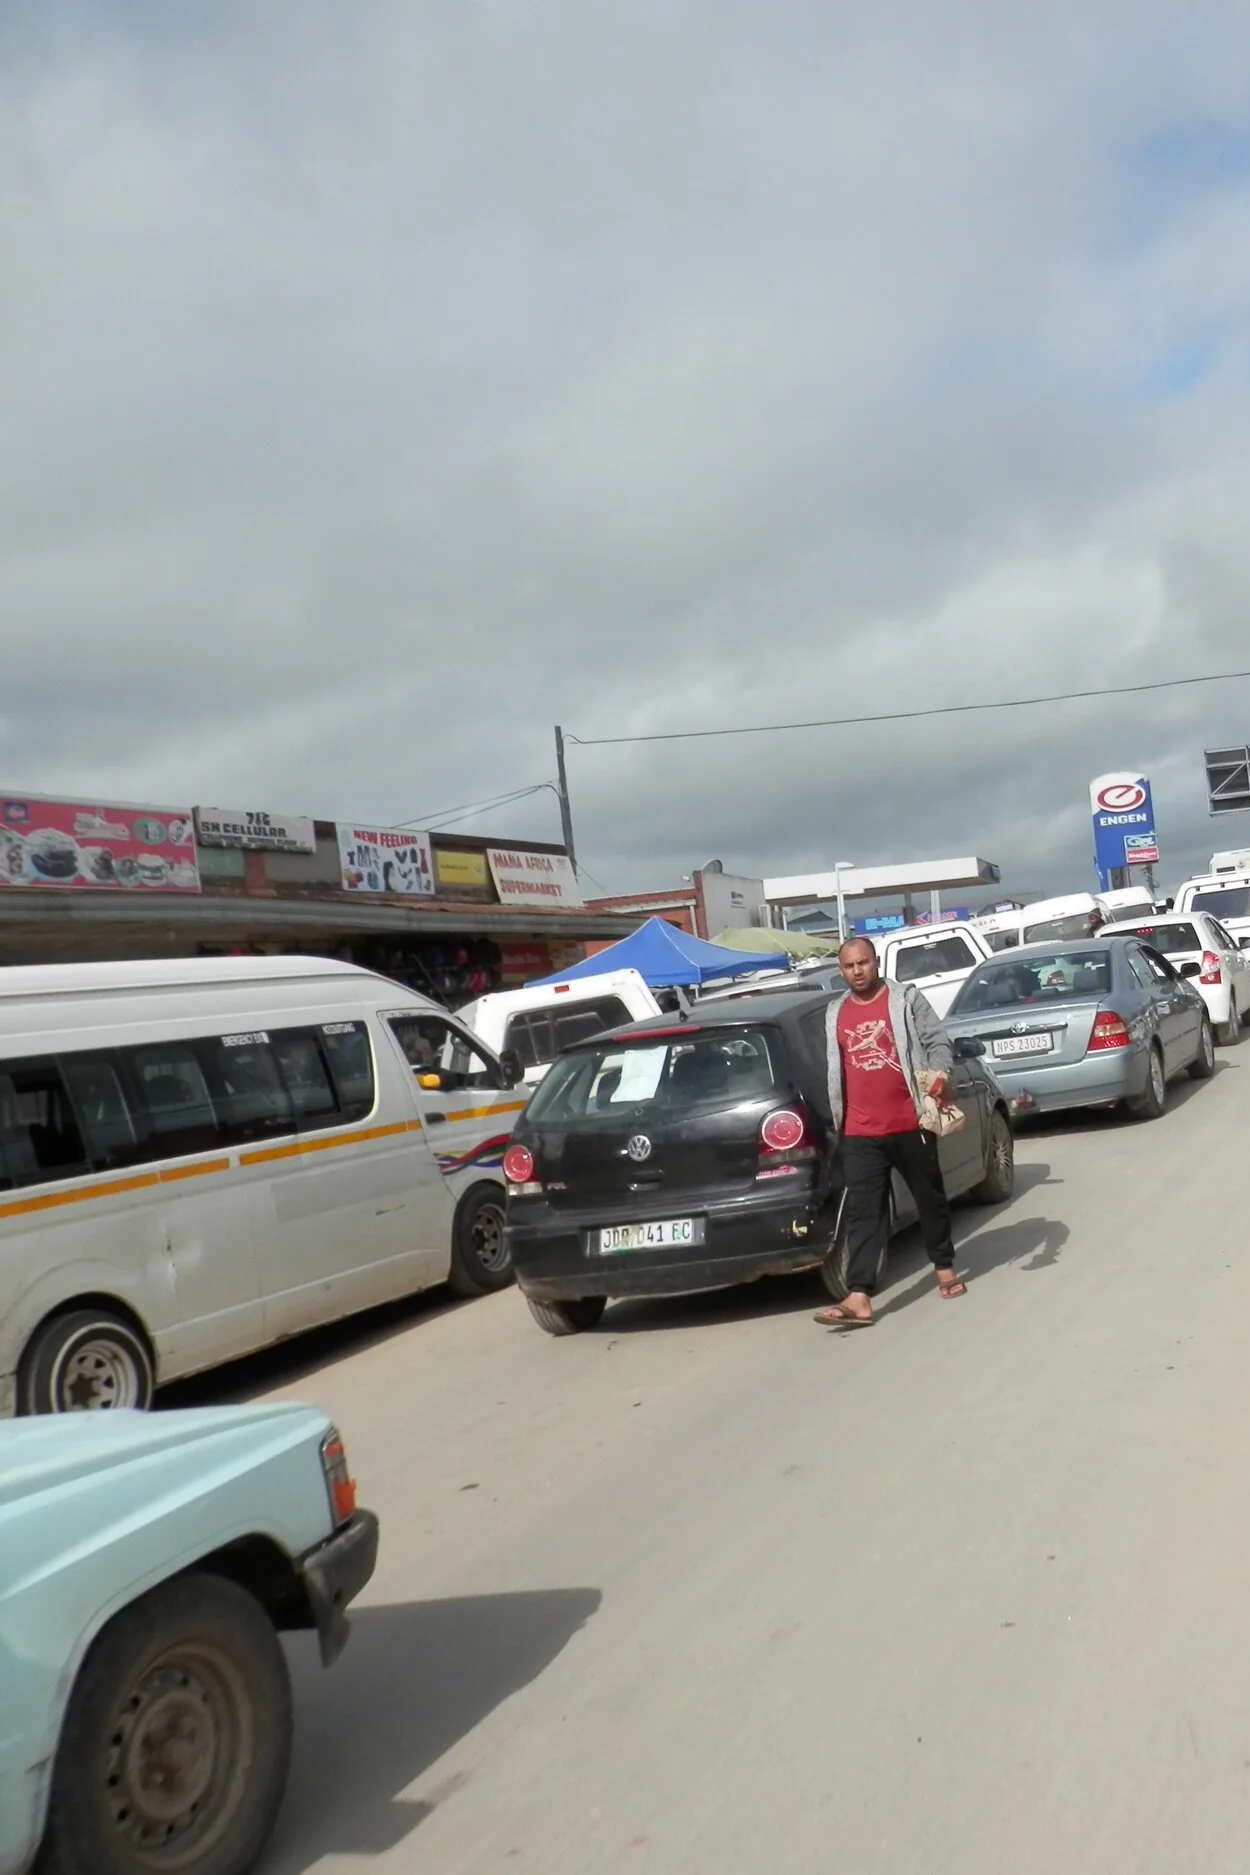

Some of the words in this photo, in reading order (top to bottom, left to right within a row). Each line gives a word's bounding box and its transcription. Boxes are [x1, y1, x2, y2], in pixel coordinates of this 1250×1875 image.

[1099, 813, 1147, 826] ENGEN
[222, 823, 287, 838] CELLULAR
[353, 829, 378, 845] NEW
[380, 832, 418, 848] FEELING
[493, 853, 522, 869] MAMA
[500, 880, 562, 897] SUPERMARKET
[996, 1040, 1015, 1053] NPS
[1019, 1036, 1048, 1051] 23025
[671, 1221, 691, 1241] EC
